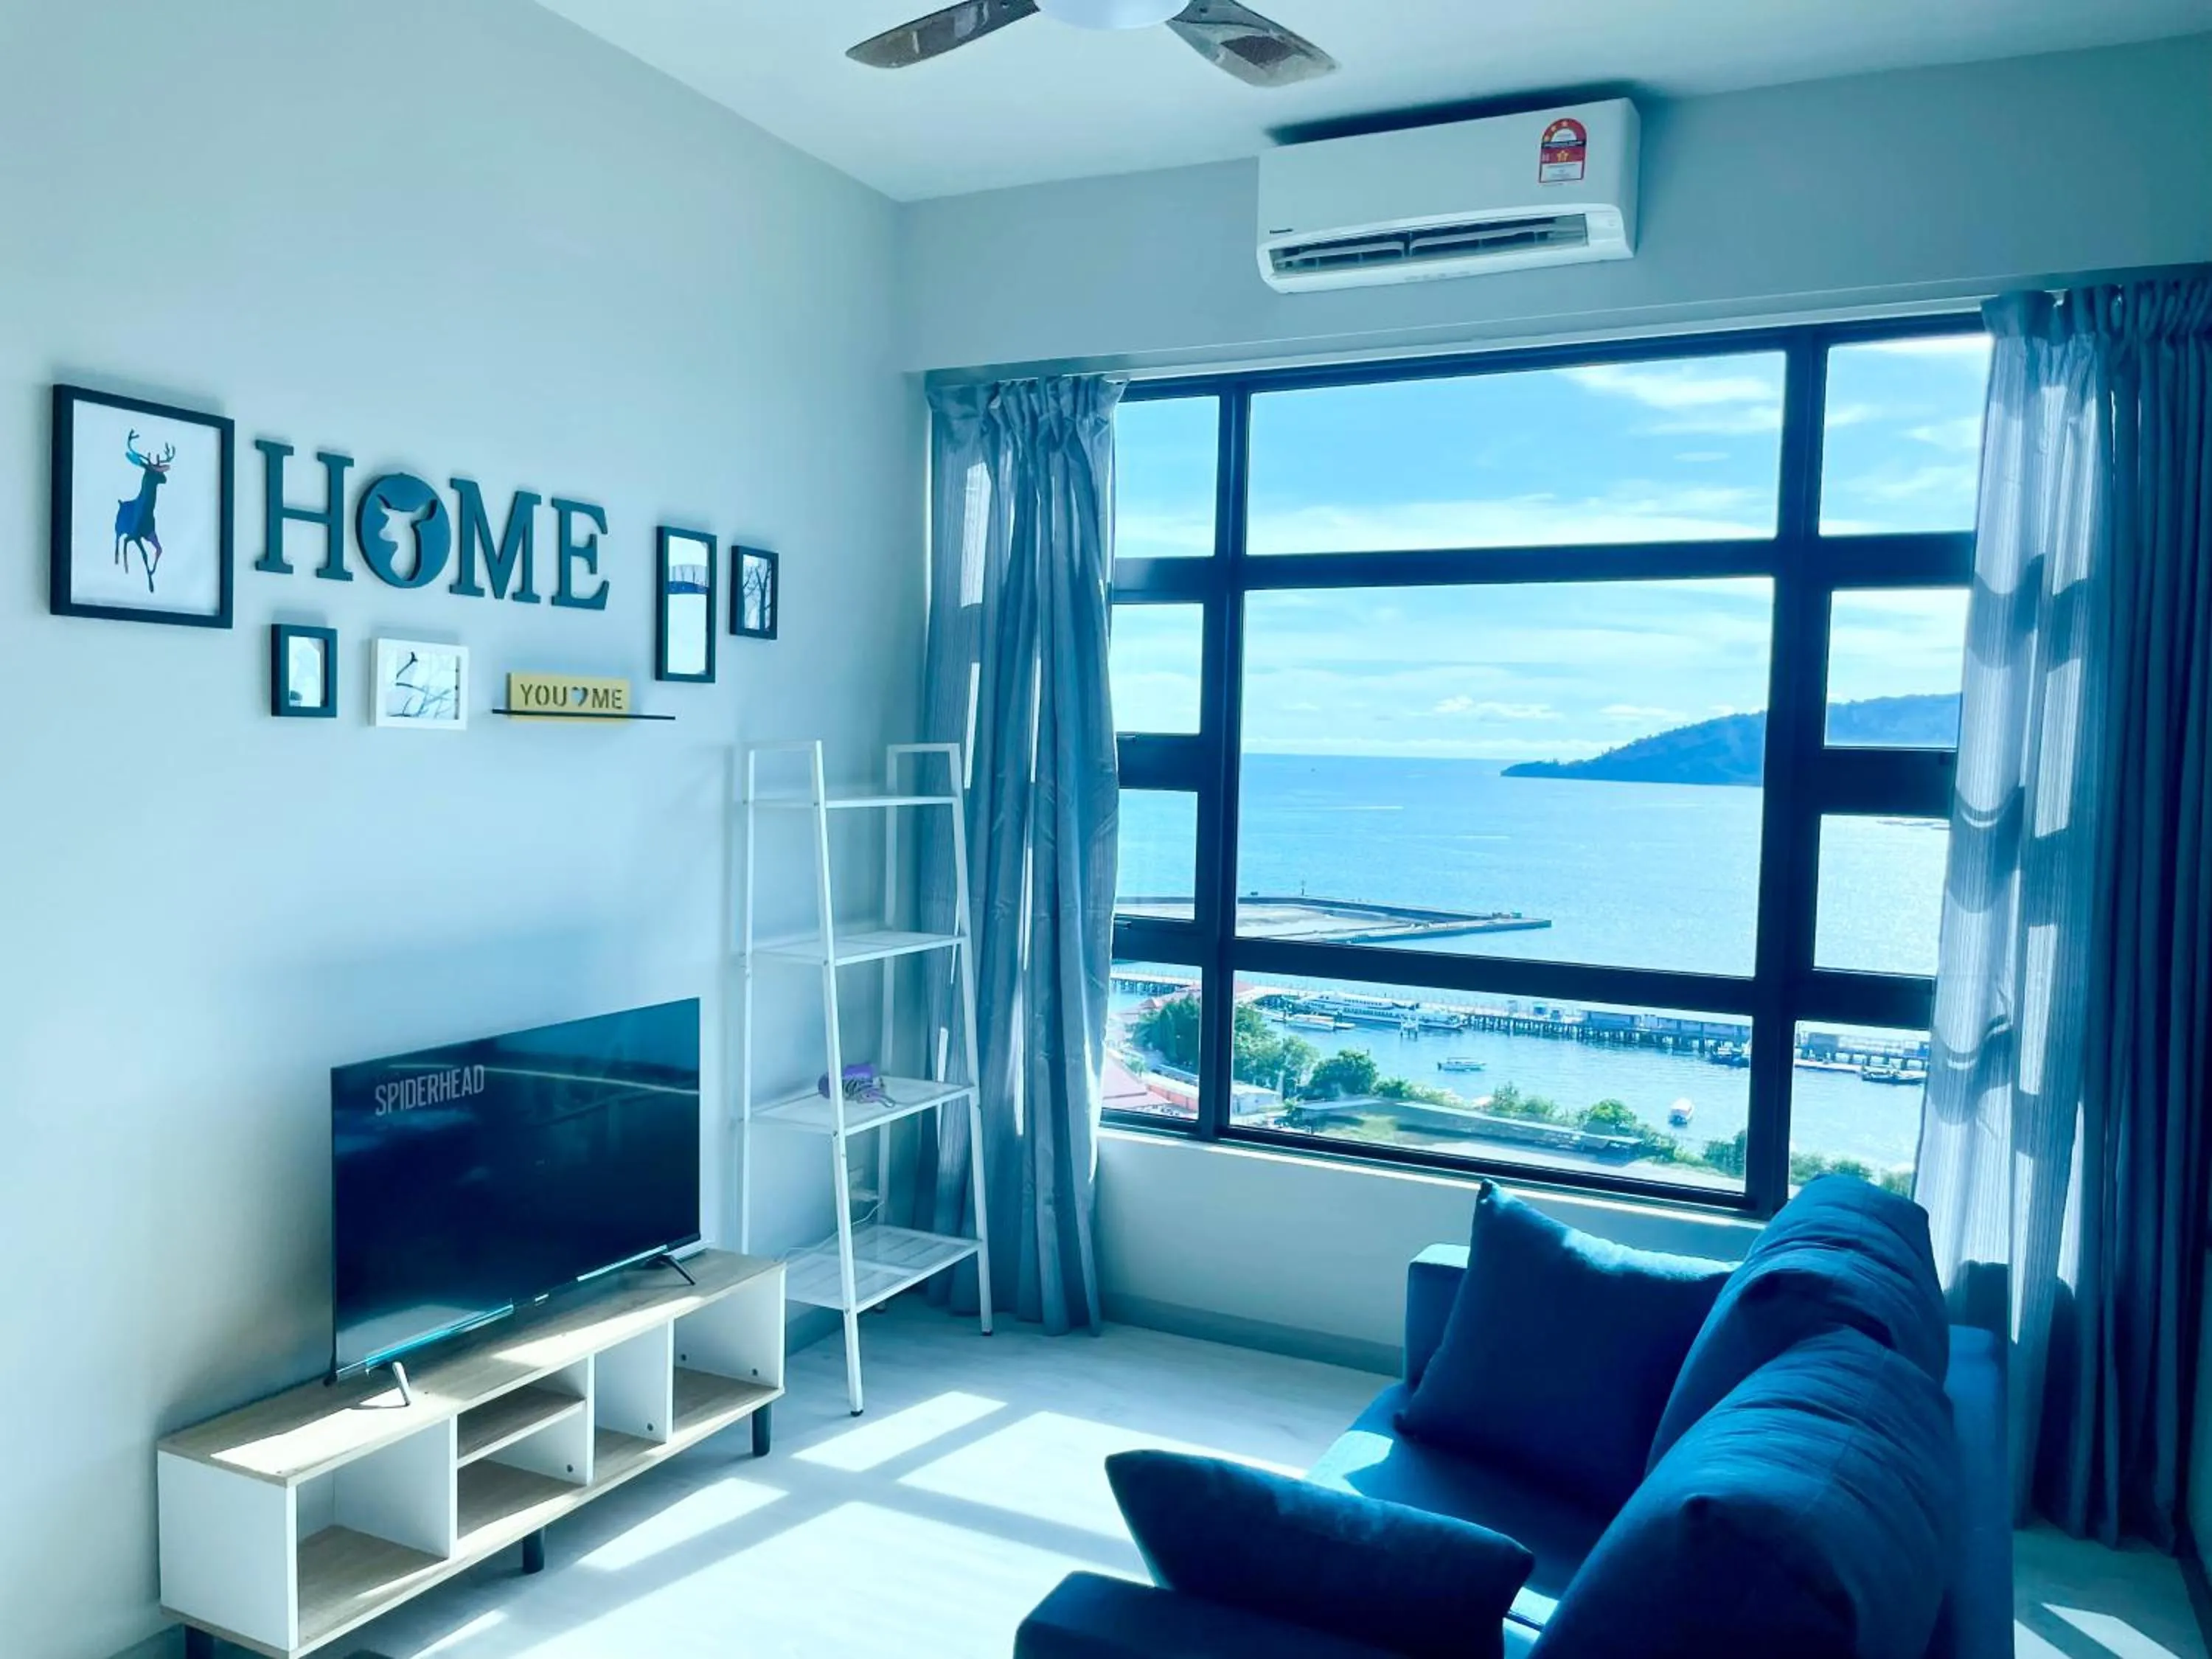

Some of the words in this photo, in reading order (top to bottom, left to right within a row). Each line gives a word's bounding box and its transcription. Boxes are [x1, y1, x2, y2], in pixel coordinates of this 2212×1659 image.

[255, 439, 610, 611] HOME
[520, 684, 567, 707] YOU
[592, 688, 623, 709] ME
[375, 1064, 484, 1116] SPIDERHEAD
